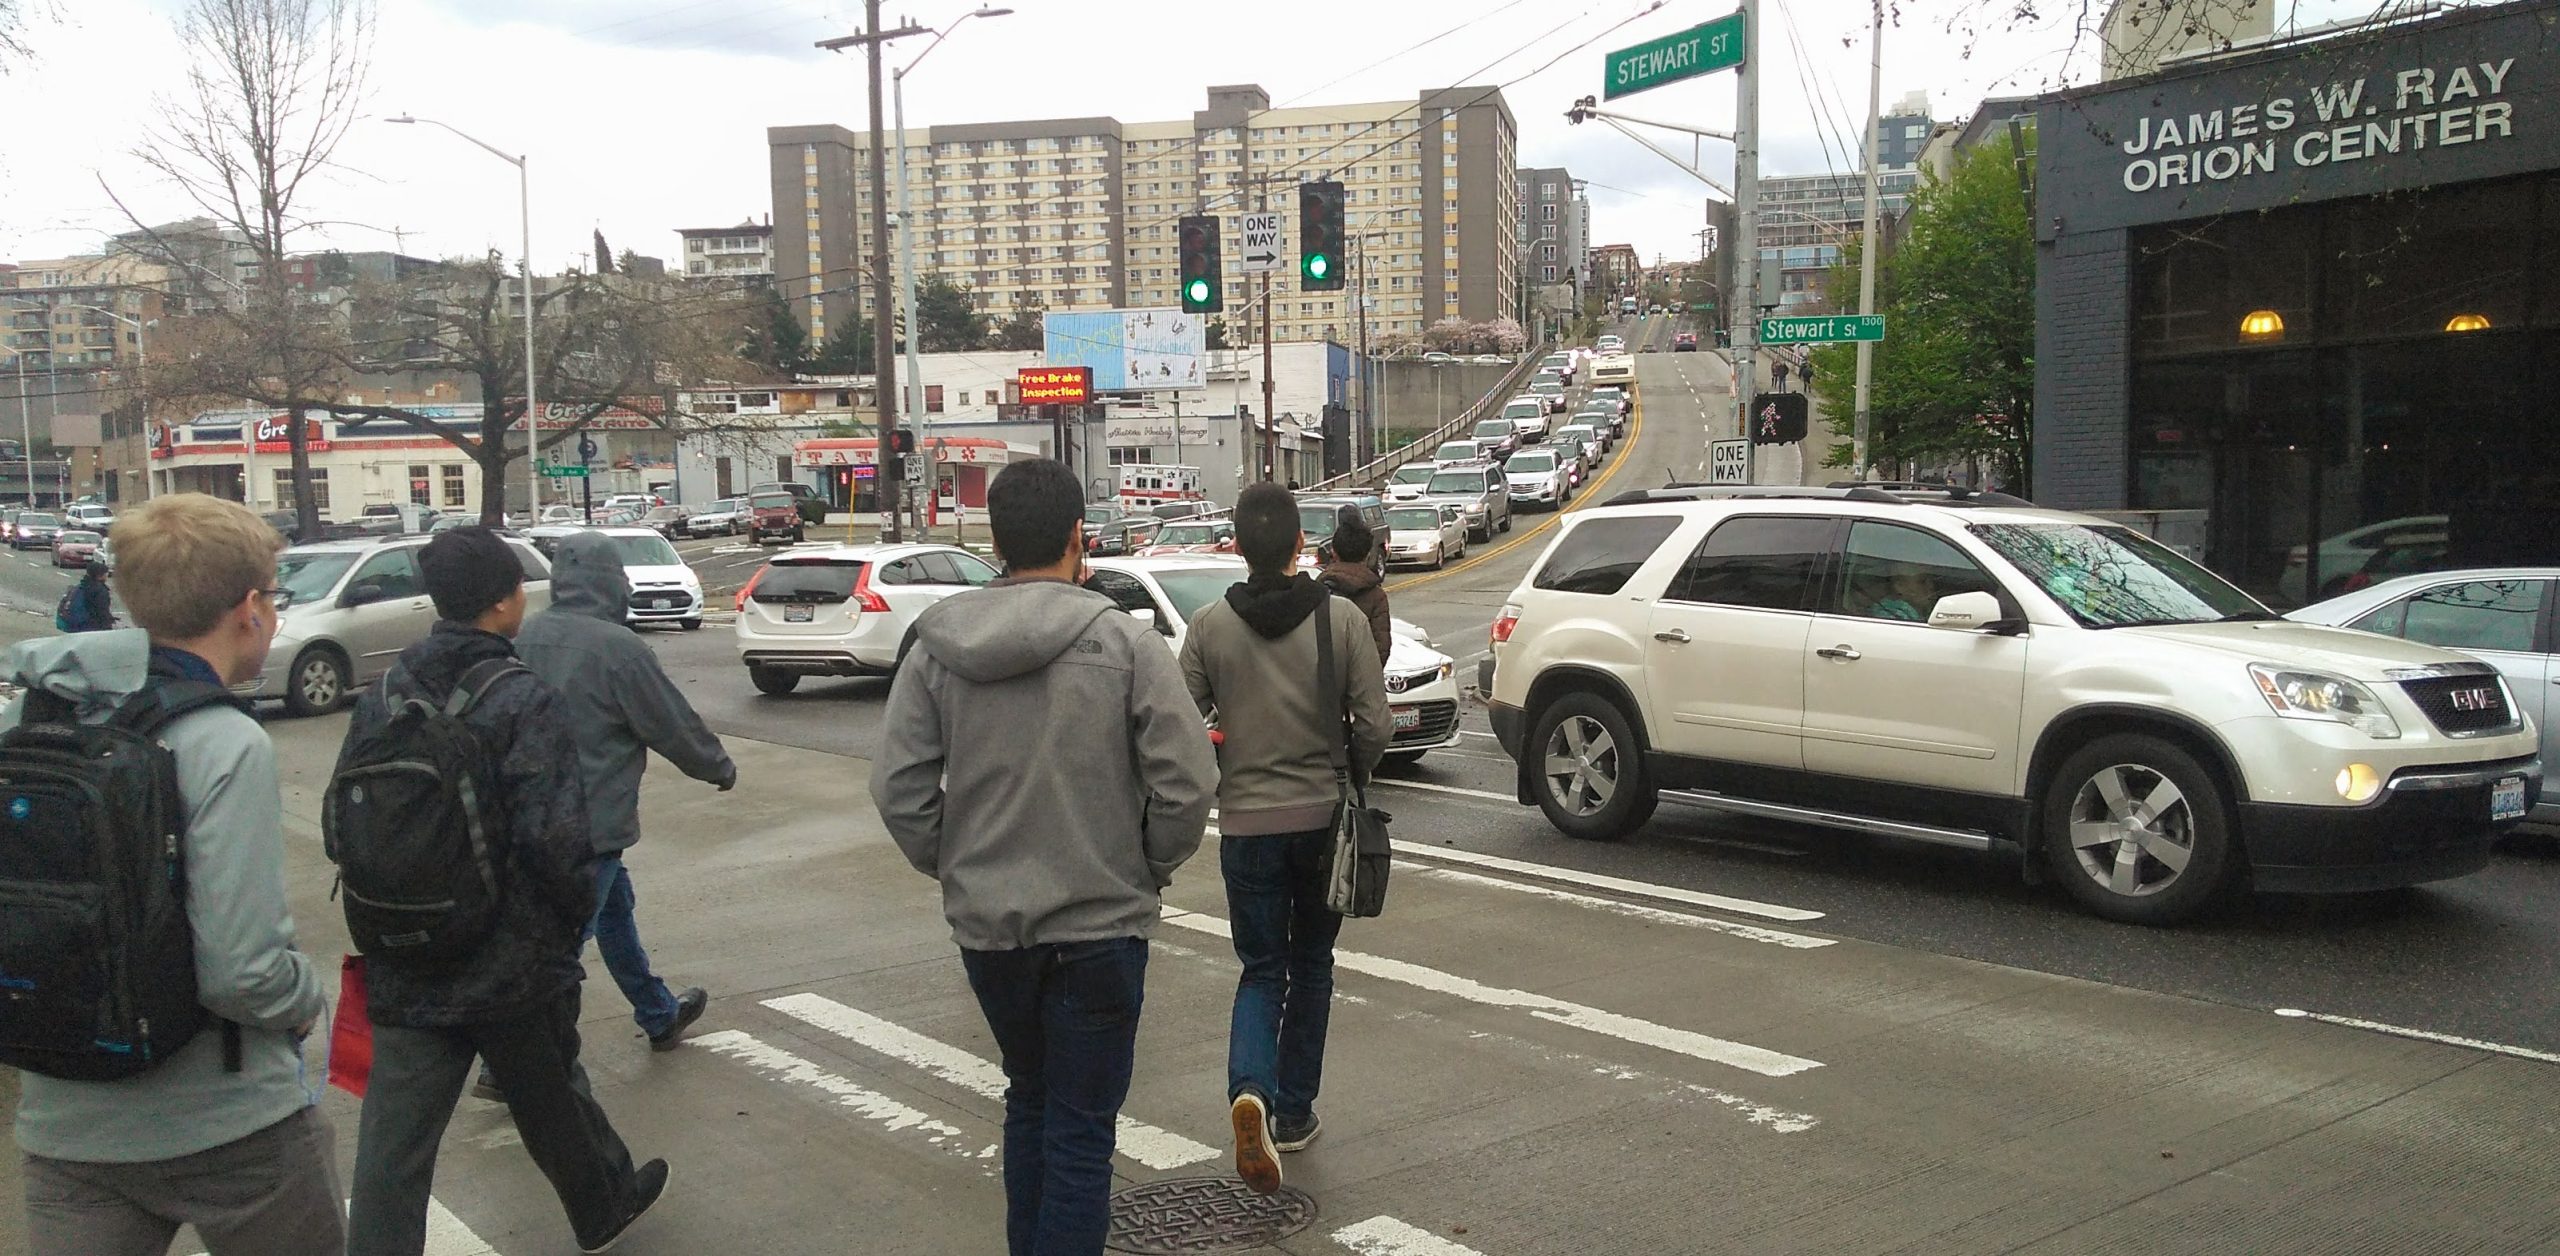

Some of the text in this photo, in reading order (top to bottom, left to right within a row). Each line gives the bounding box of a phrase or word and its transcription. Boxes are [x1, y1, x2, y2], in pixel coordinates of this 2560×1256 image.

[1617, 33, 1729, 85] STEWART ST
[2123, 58, 2515, 155] JAMES W. RAY
[2123, 102, 2513, 193] ORION CENTER
[1246, 216, 1277, 231] ONE
[1246, 232, 1277, 247] WAY
[1766, 317, 1883, 339] Stewart St 1300
[1019, 373, 1082, 384] Free Brake
[1022, 386, 1084, 398] Inspection
[907, 457, 922, 467] ONE
[1716, 445, 1745, 462] ONE
[1715, 464, 1745, 480] WAY
[2450, 687, 2499, 711] GMC
[1128, 1197, 1265, 1226] WATER
